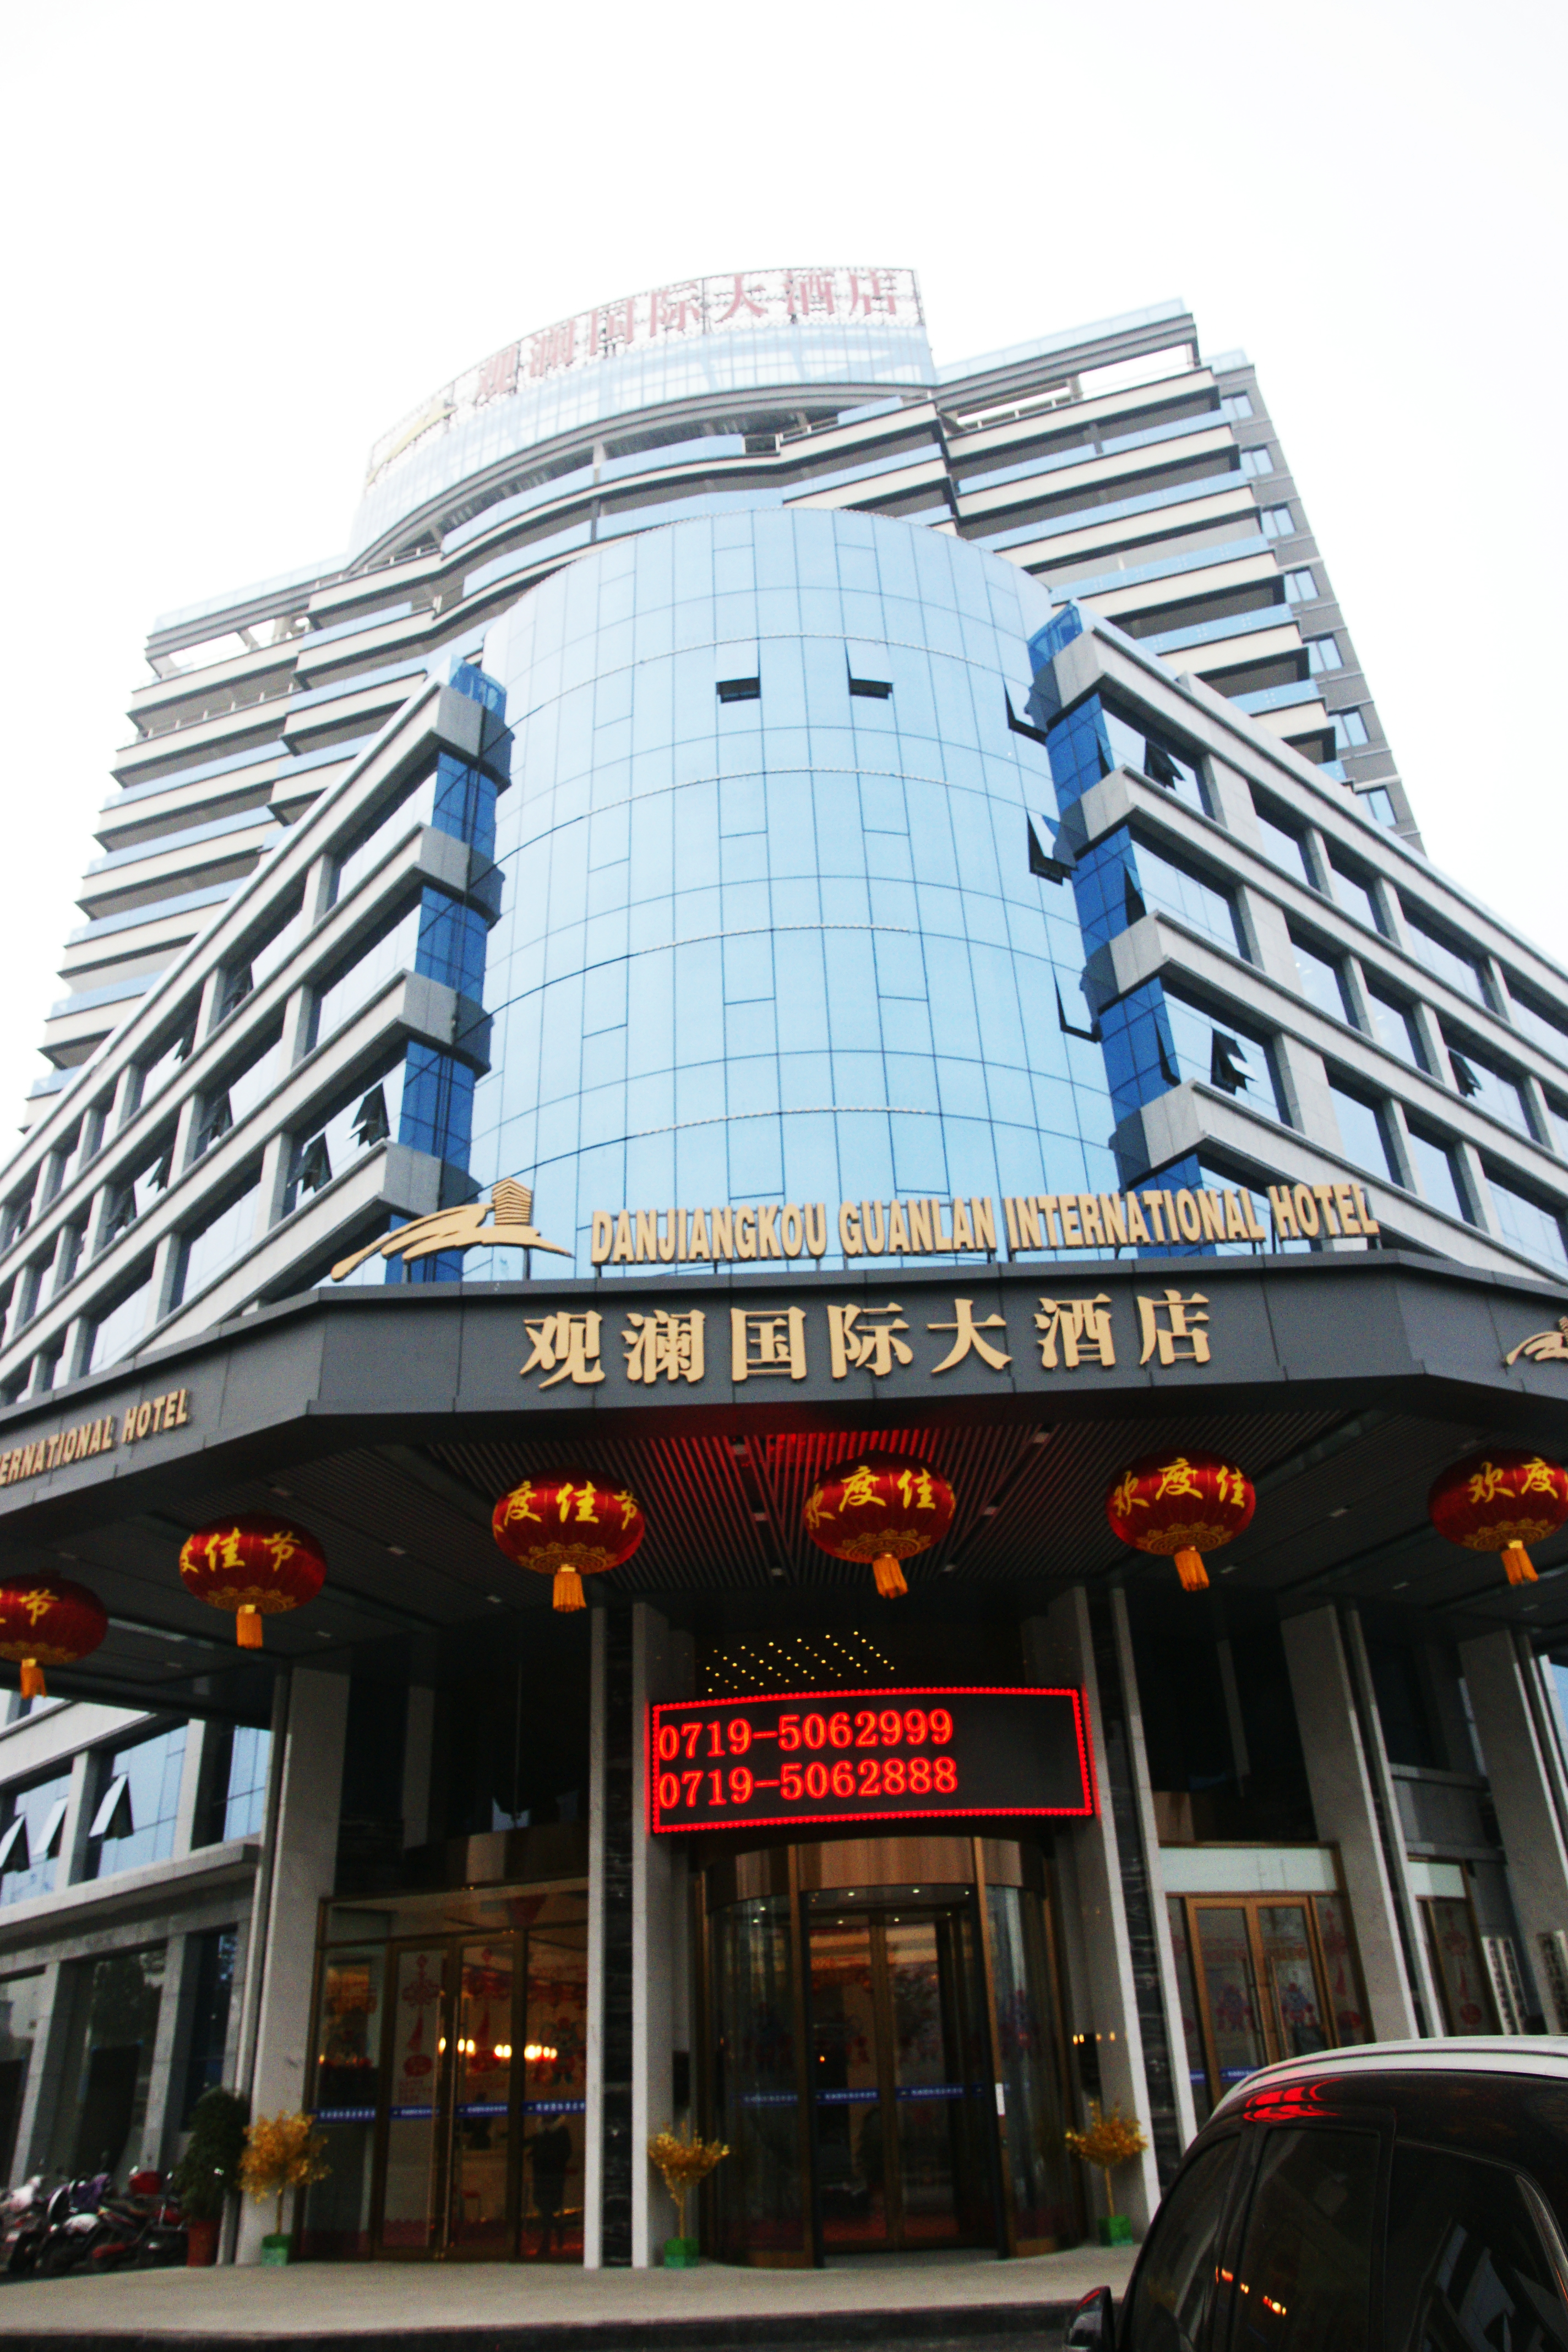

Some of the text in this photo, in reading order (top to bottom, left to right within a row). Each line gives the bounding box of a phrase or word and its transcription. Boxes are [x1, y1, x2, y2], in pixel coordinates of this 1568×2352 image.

[591, 1183, 1380, 1263] DANJIANGKOU GUANLAN INTERNATIONAL HOTEL
[519, 1289, 1211, 1389] 观澜国际大酒店
[122, 1389, 188, 1444] HOTEL
[494, 1480, 639, 1533] 度佳节
[805, 1465, 956, 1529] 欢度佳
[1468, 1456, 1568, 1504] 欢度
[660, 1708, 954, 1761] 0719-5062999
[660, 1756, 959, 1809] 0719-5062888
